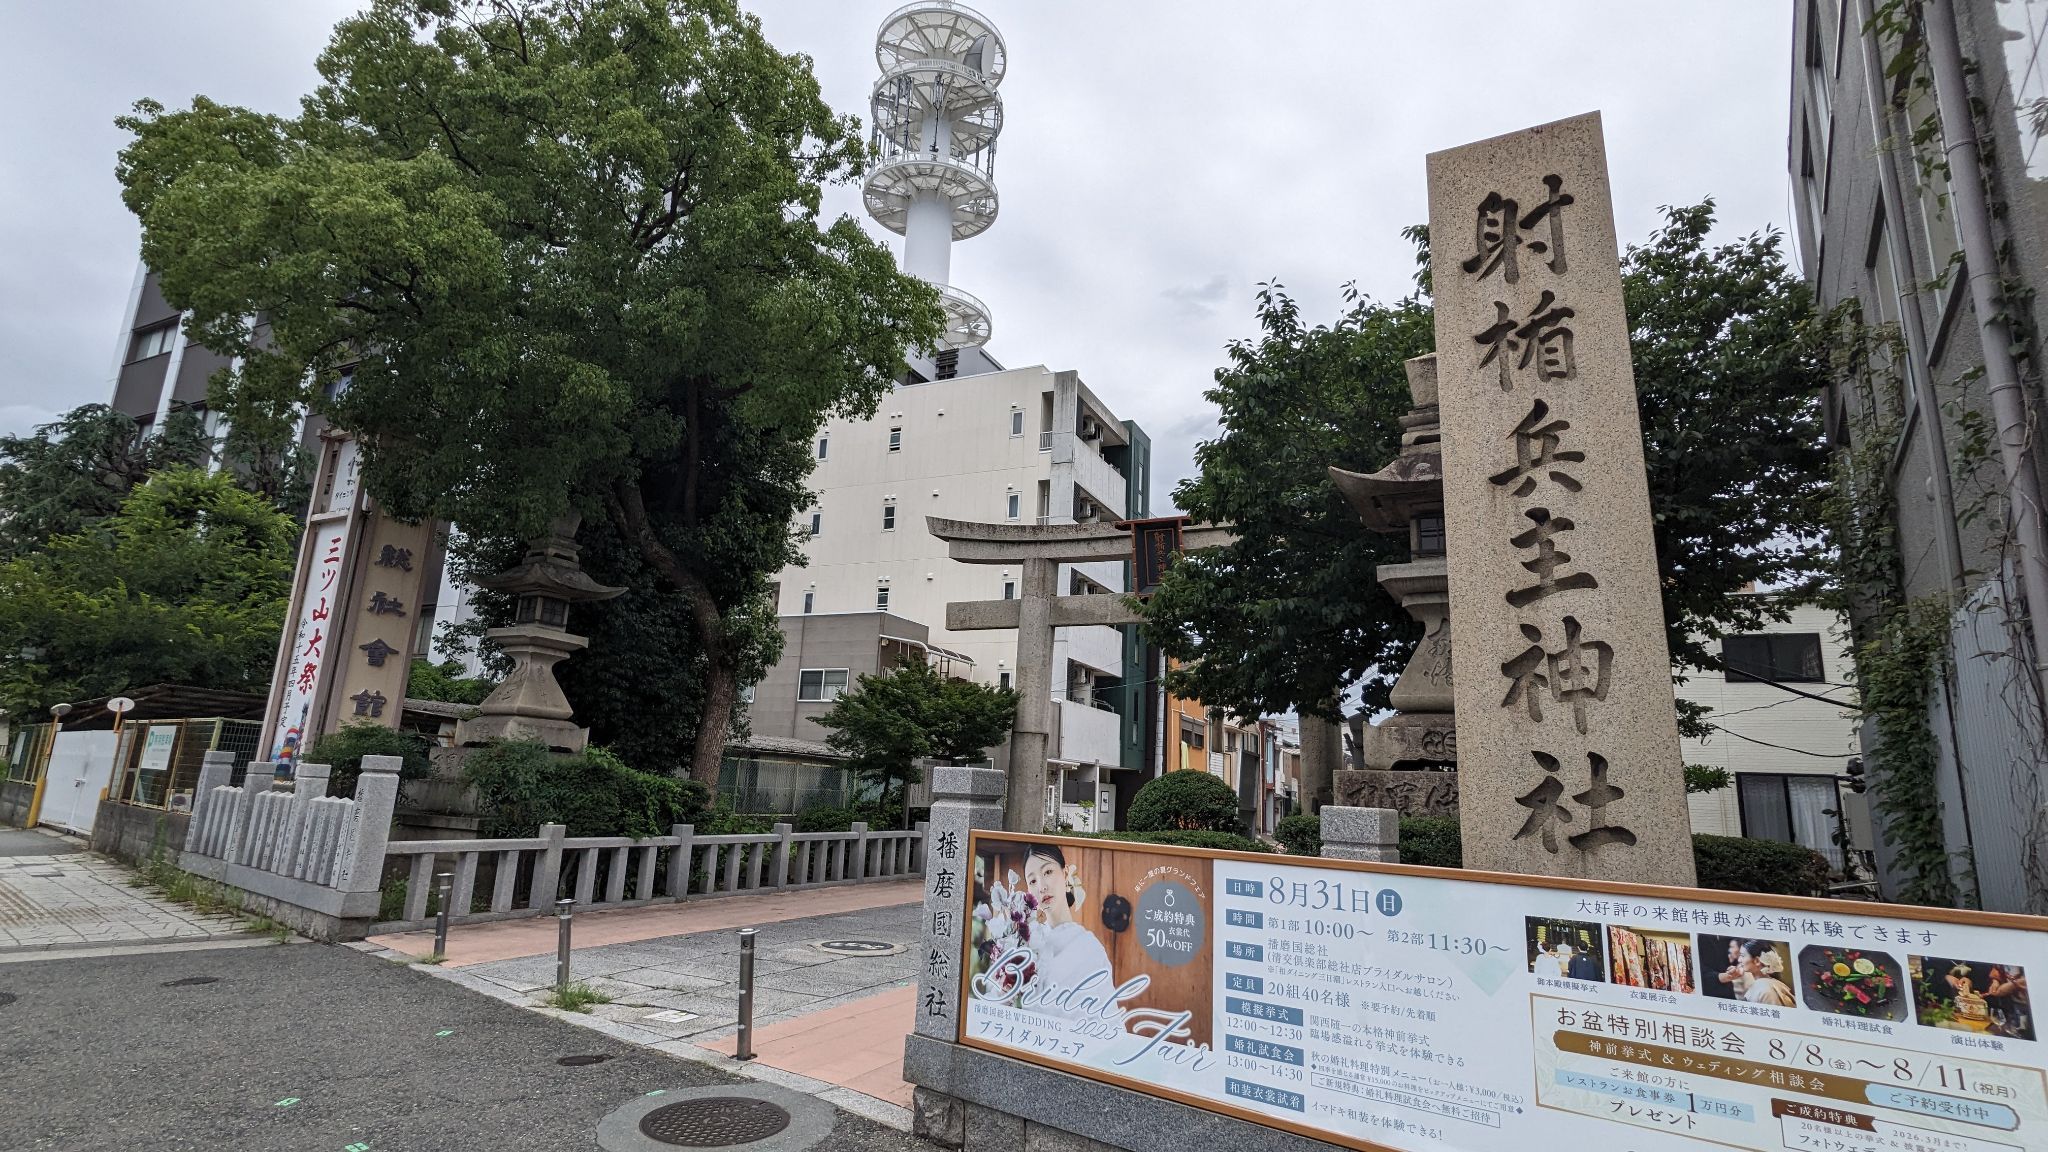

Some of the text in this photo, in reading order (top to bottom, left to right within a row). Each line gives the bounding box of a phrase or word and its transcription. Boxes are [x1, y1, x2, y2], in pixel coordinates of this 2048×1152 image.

[1461, 172, 1638, 855] 射楯兵主神社
[297, 536, 342, 695] 三ツ山大祭
[1233, 881, 1256, 895] 日時
[1268, 876, 1370, 914] 8月31日
[1144, 909, 1196, 926] ご成約特典
[1232, 911, 1255, 926] 時間
[1576, 898, 1938, 946] 大好評の来館特典が全部体験できます
[1233, 937, 1329, 958] 場所 播磨国総社
[971, 947, 1150, 1020] Bridal
[1233, 976, 1256, 991] 定員
[1267, 981, 1351, 1007] 20組40名様
[1240, 1001, 1430, 1047] 模擬挙式 関西随一の本格神前挙式
[1718, 1002, 1781, 1019] 和装衣裳試着
[1821, 1015, 1894, 1035] 婚礼料理試食
[980, 1020, 1085, 1058] ブライダルフェア
[1069, 1018, 1122, 1041] 2025
[1112, 1007, 1217, 1073] Fair
[1557, 1007, 1746, 1055] お盆特別相談会
[1950, 1034, 2004, 1051] 演出体験
[1234, 1038, 1295, 1062] 婚礼試食会
[1309, 1028, 1465, 1068] 臨場感溢れる挙式を体験できる
[1589, 1039, 1652, 1062] 神前挙式
[1662, 1053, 1674, 1066] &
[1609, 1067, 1690, 1090] ご来館の方に
[1229, 1081, 1443, 1140] 和装衣裳試着 イマドキ和装を体験できる!
[1609, 1100, 1697, 1130] プレゼント
[1786, 1103, 1859, 1127] ご成約特典
[1890, 1092, 1990, 1120] ご予約受付中
